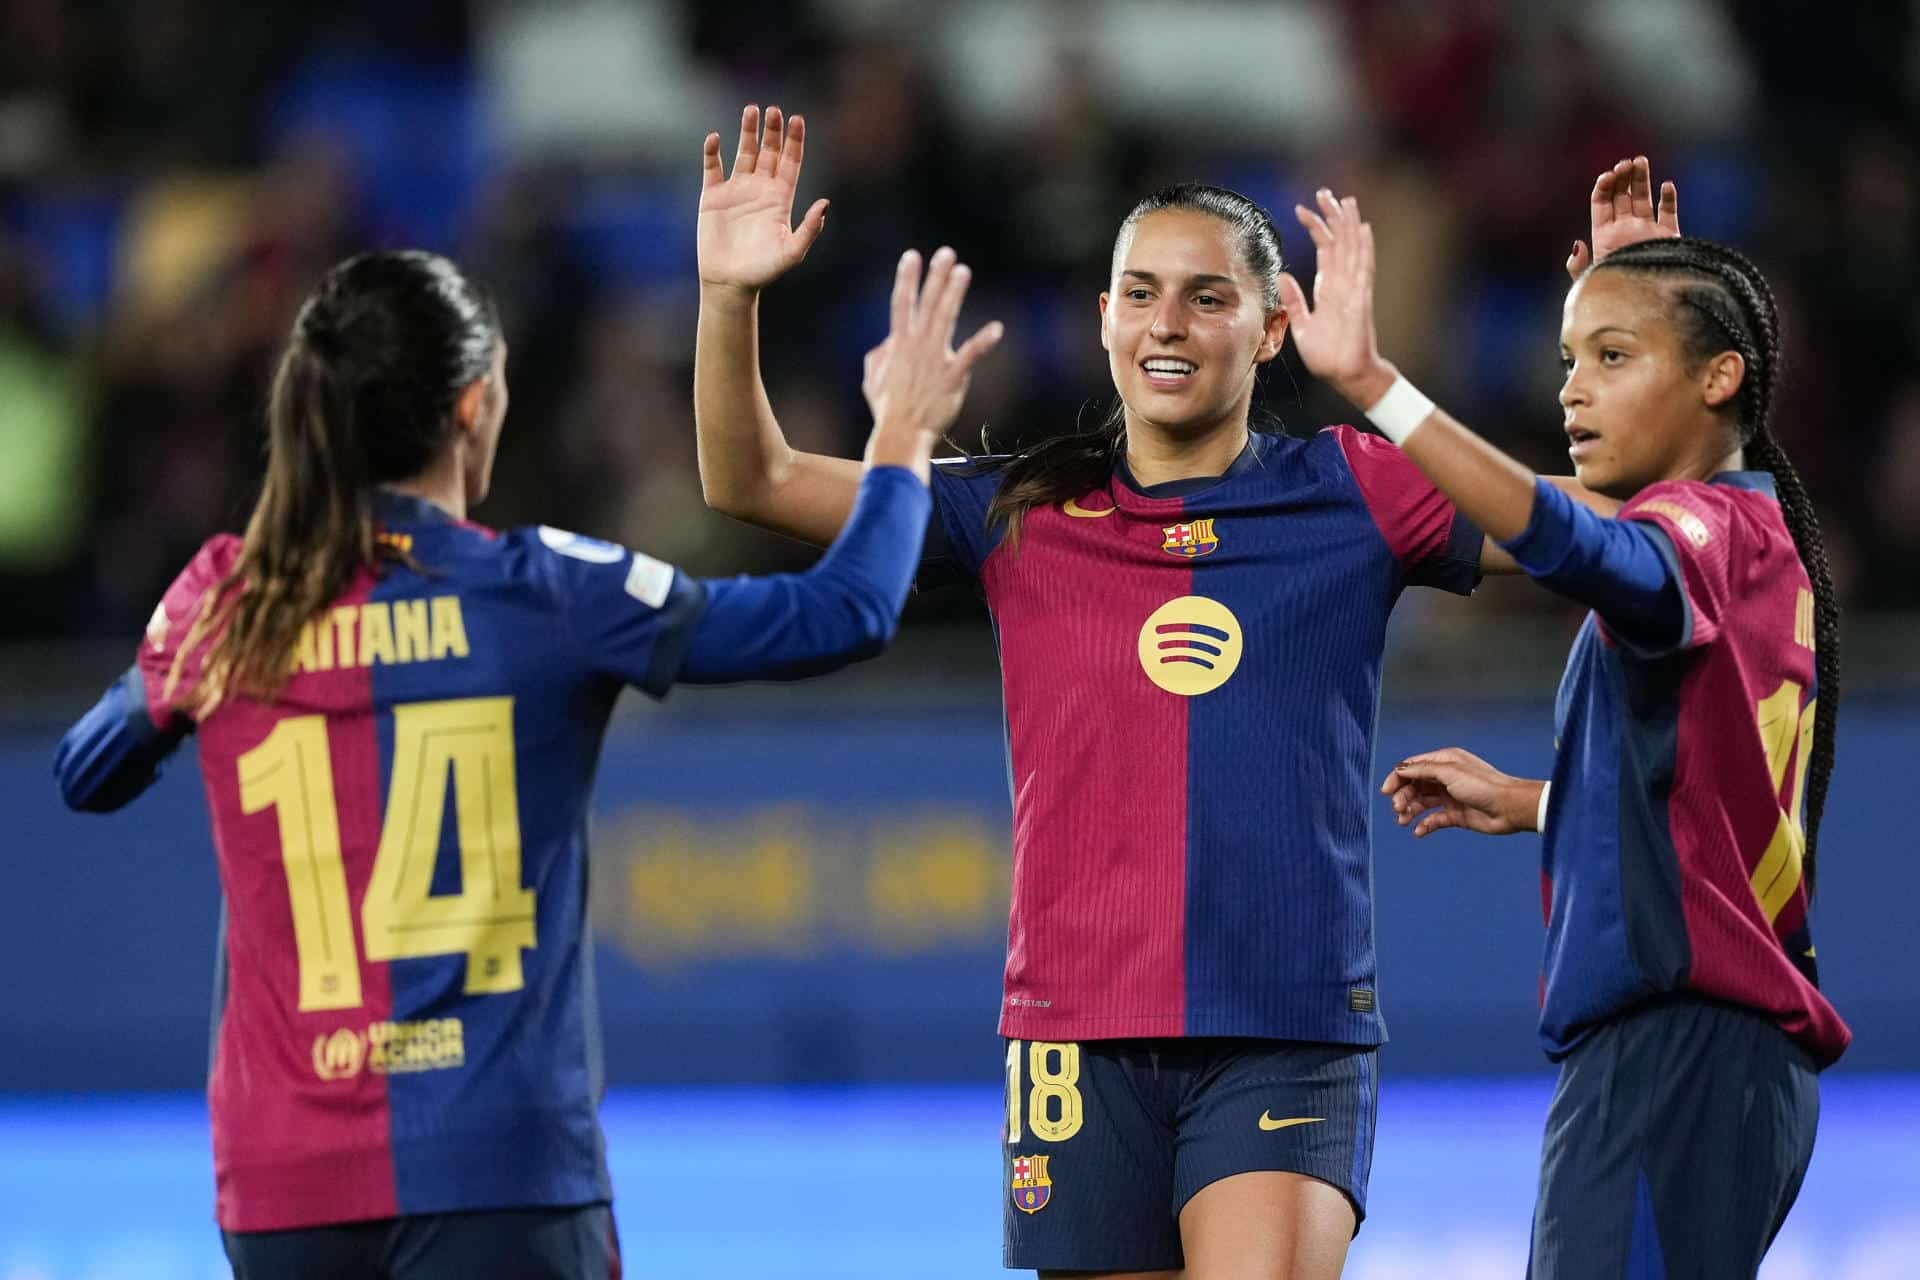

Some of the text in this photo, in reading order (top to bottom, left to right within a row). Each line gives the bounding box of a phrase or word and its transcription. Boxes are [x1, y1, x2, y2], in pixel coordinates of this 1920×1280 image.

[290, 596, 469, 673] AITANA
[237, 696, 537, 1012] 14
[1007, 1040, 1083, 1143] 18
[1021, 1179, 1038, 1187] FCB
